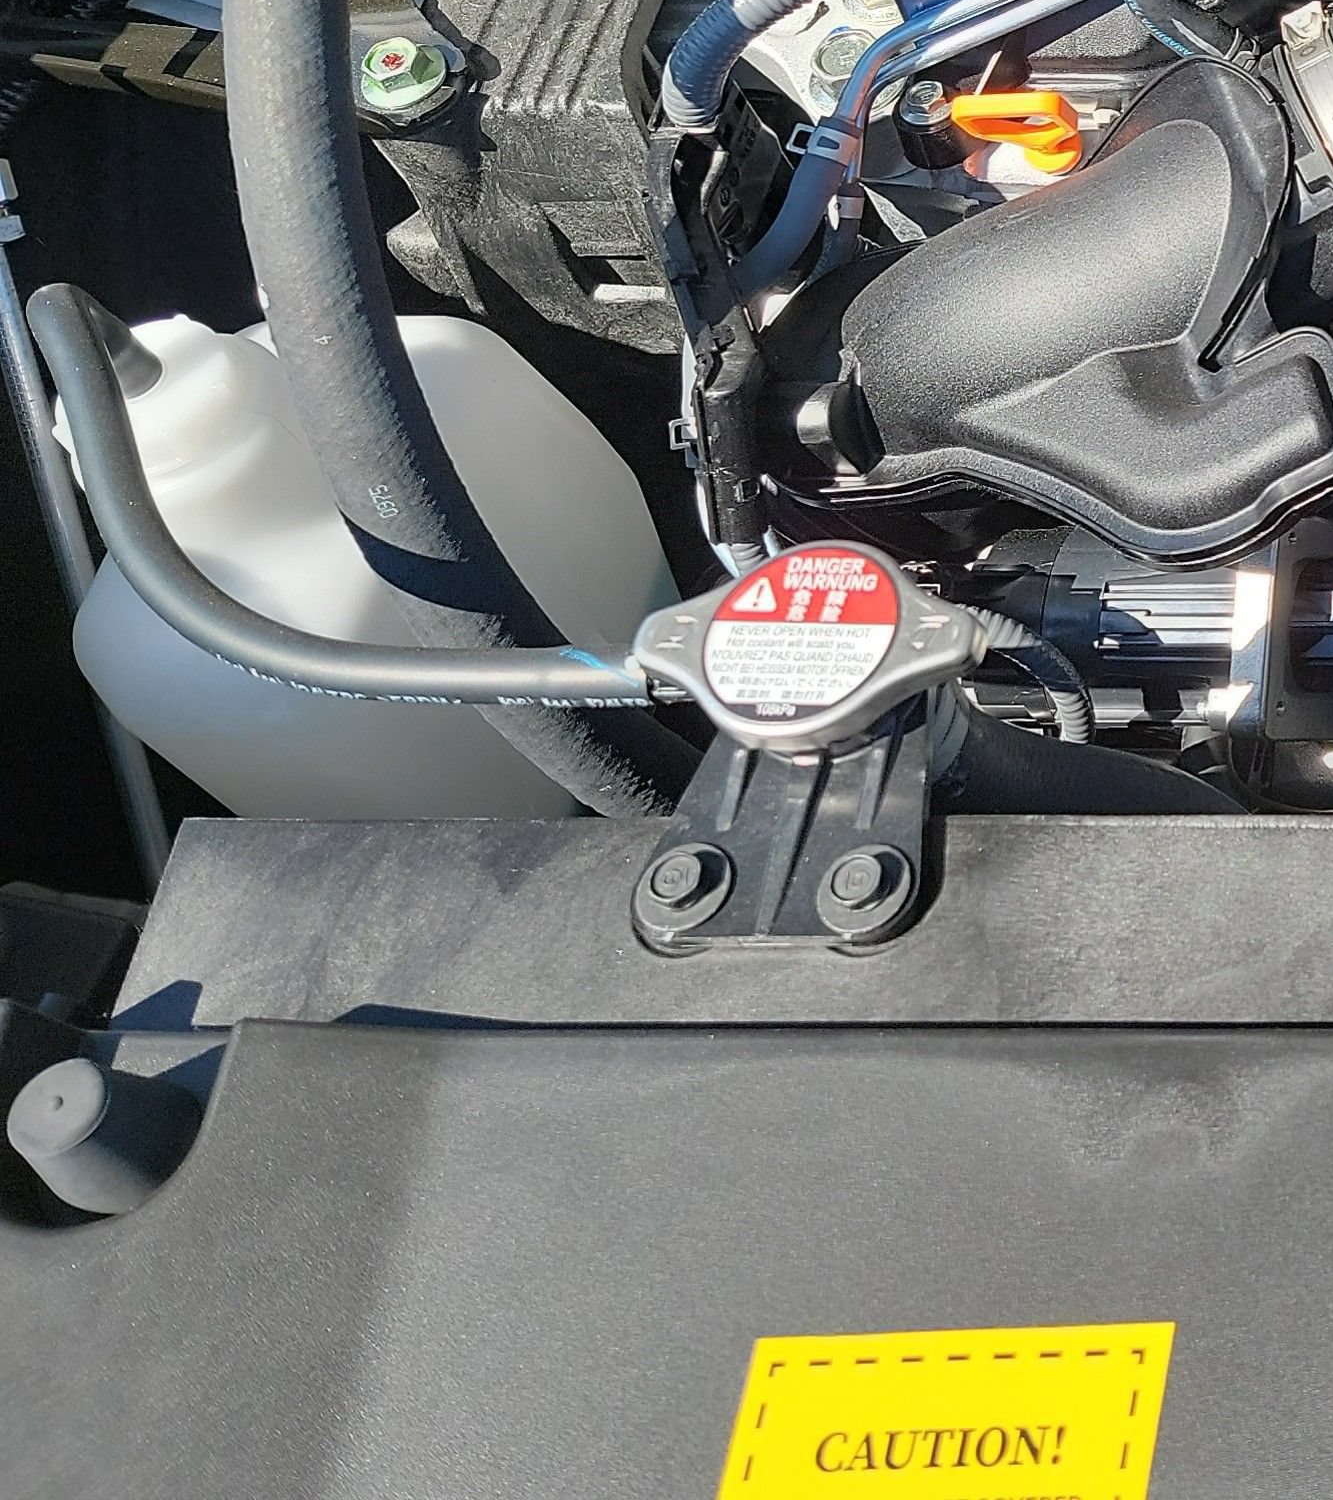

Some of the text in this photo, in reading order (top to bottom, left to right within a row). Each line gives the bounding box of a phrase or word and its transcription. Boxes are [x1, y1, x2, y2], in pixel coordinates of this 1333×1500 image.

[786, 556, 865, 574] DANGER
[783, 572, 878, 592] WARNUNG
[730, 625, 770, 637] NEVER
[772, 626, 806, 637] OPEN
[809, 626, 845, 638] WHEN
[726, 637, 745, 649] Hot
[746, 637, 786, 649] coolant
[768, 650, 791, 661] PAS
[793, 651, 833, 662] QUAND
[711, 663, 740, 674] NICHT
[796, 664, 829, 675] MOTOR
[815, 1424, 1068, 1474] CAUTION!
